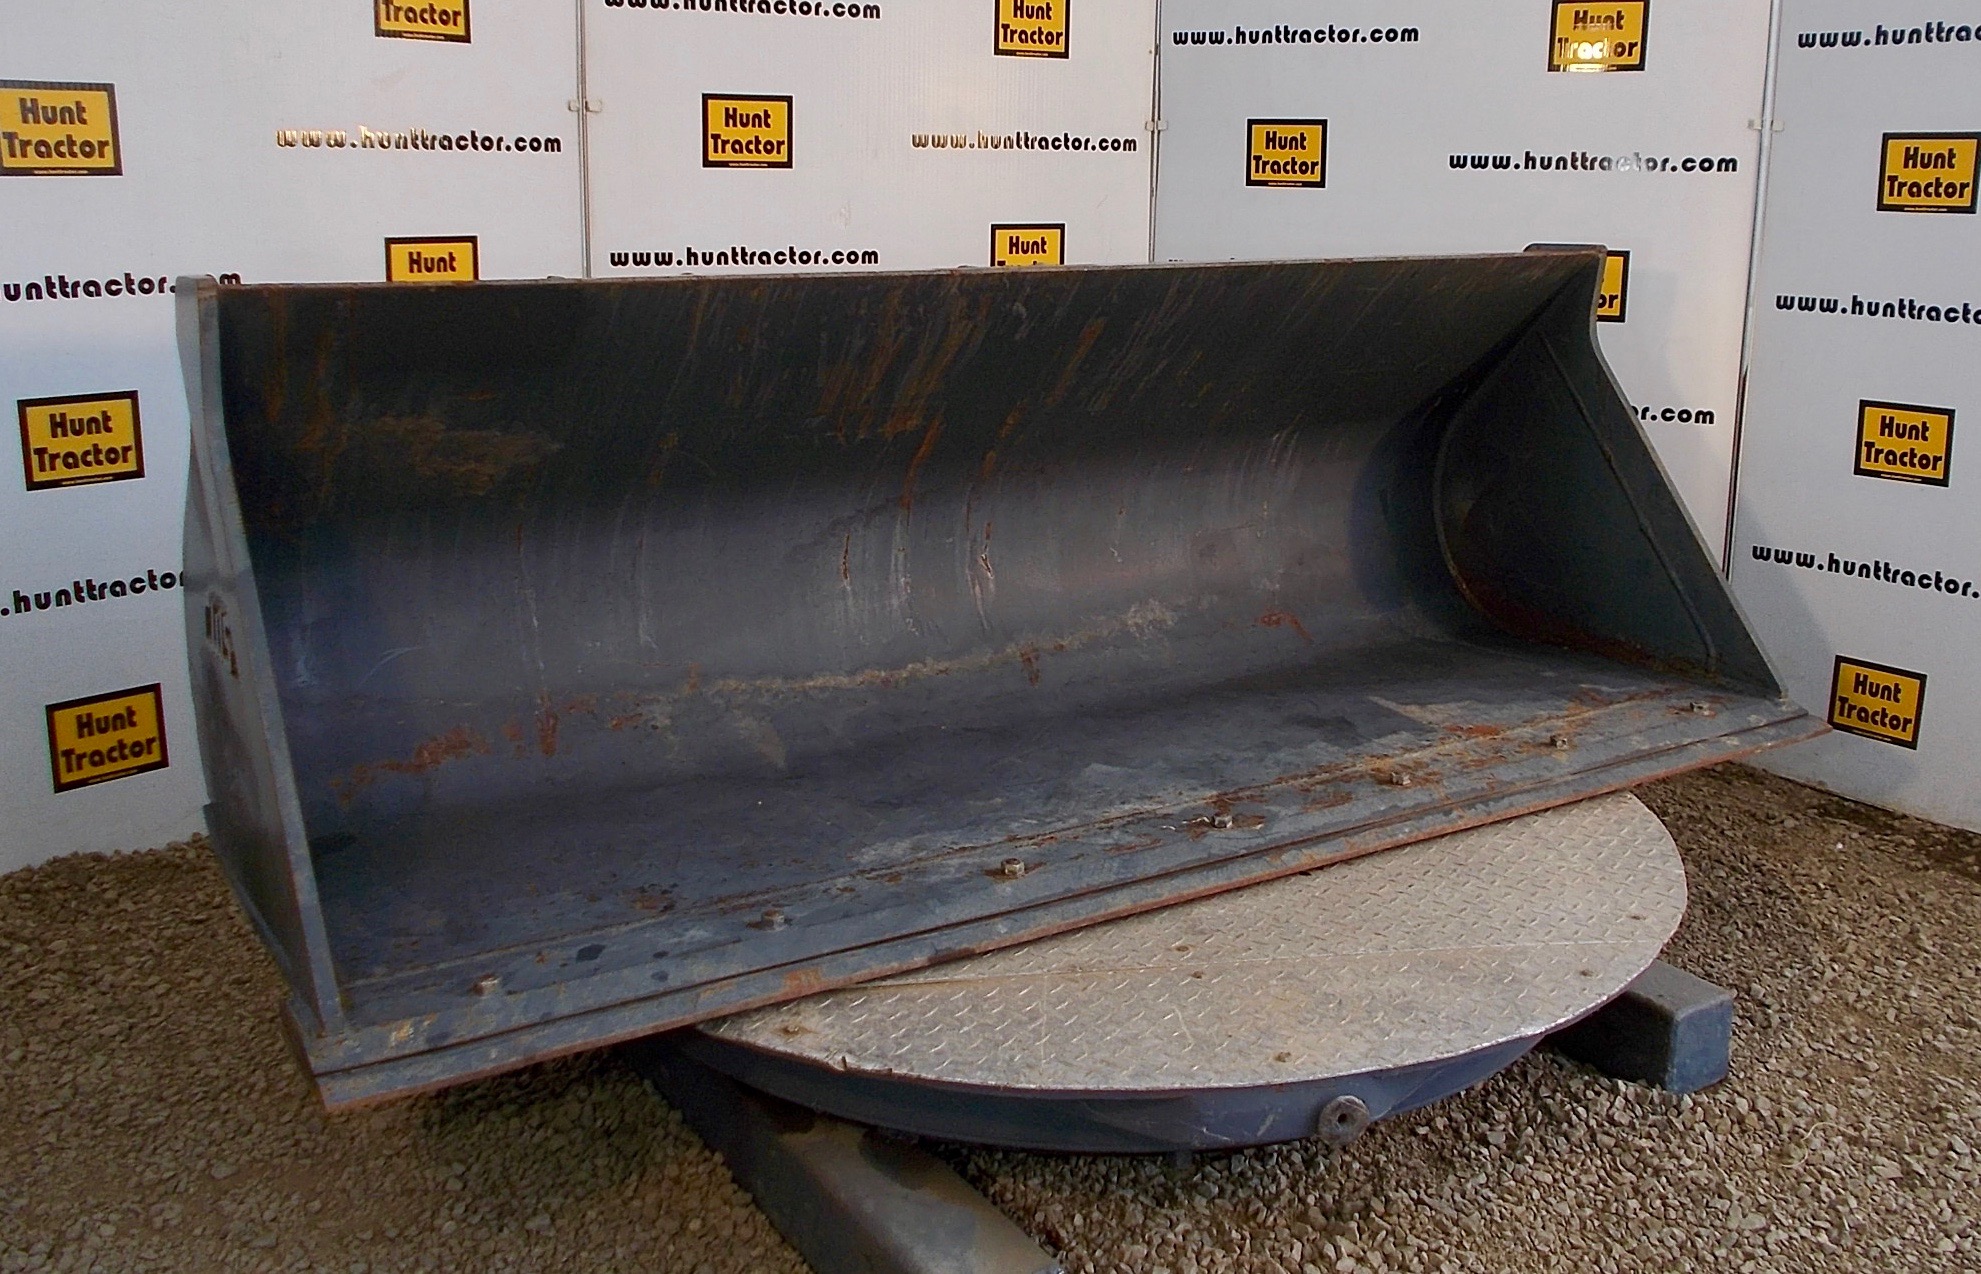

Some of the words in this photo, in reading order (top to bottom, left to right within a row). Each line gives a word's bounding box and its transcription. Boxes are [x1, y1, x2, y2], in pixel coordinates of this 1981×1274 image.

[382, 0, 462, 27] Tractor
[1013, 0, 1052, 20] Hunt
[1573, 9, 1625, 31] Hunt
[1001, 23, 1064, 46] Tractor
[1172, 24, 1420, 46] www.hunttractor.com
[19, 97, 88, 126] Hunt
[724, 106, 771, 129] Hunt
[2, 131, 110, 159] Tractor
[275, 125, 562, 153] www.hunttractor.com
[710, 133, 786, 156] Tractor
[910, 130, 1138, 152] www.hunttractor.com
[1265, 130, 1307, 151] Hunt
[1253, 155, 1319, 175] Tractor
[1448, 150, 1738, 173] www.hunttractor.com
[1902, 146, 1956, 170] Hunt
[1886, 175, 1970, 200] Tractor
[609, 246, 879, 267] www.hunttractor.com
[1008, 235, 1047, 255] Hunt
[408, 251, 457, 274] Hunt
[48, 409, 114, 439] Hunt
[1879, 415, 1930, 442] Hunt
[32, 443, 134, 473] Tractor
[1863, 441, 1943, 472] Tractor
[1852, 672, 1902, 703] Hunt
[75, 706, 138, 740] Hunt
[1837, 695, 1913, 734] Tractor
[60, 734, 159, 774] Tractor
